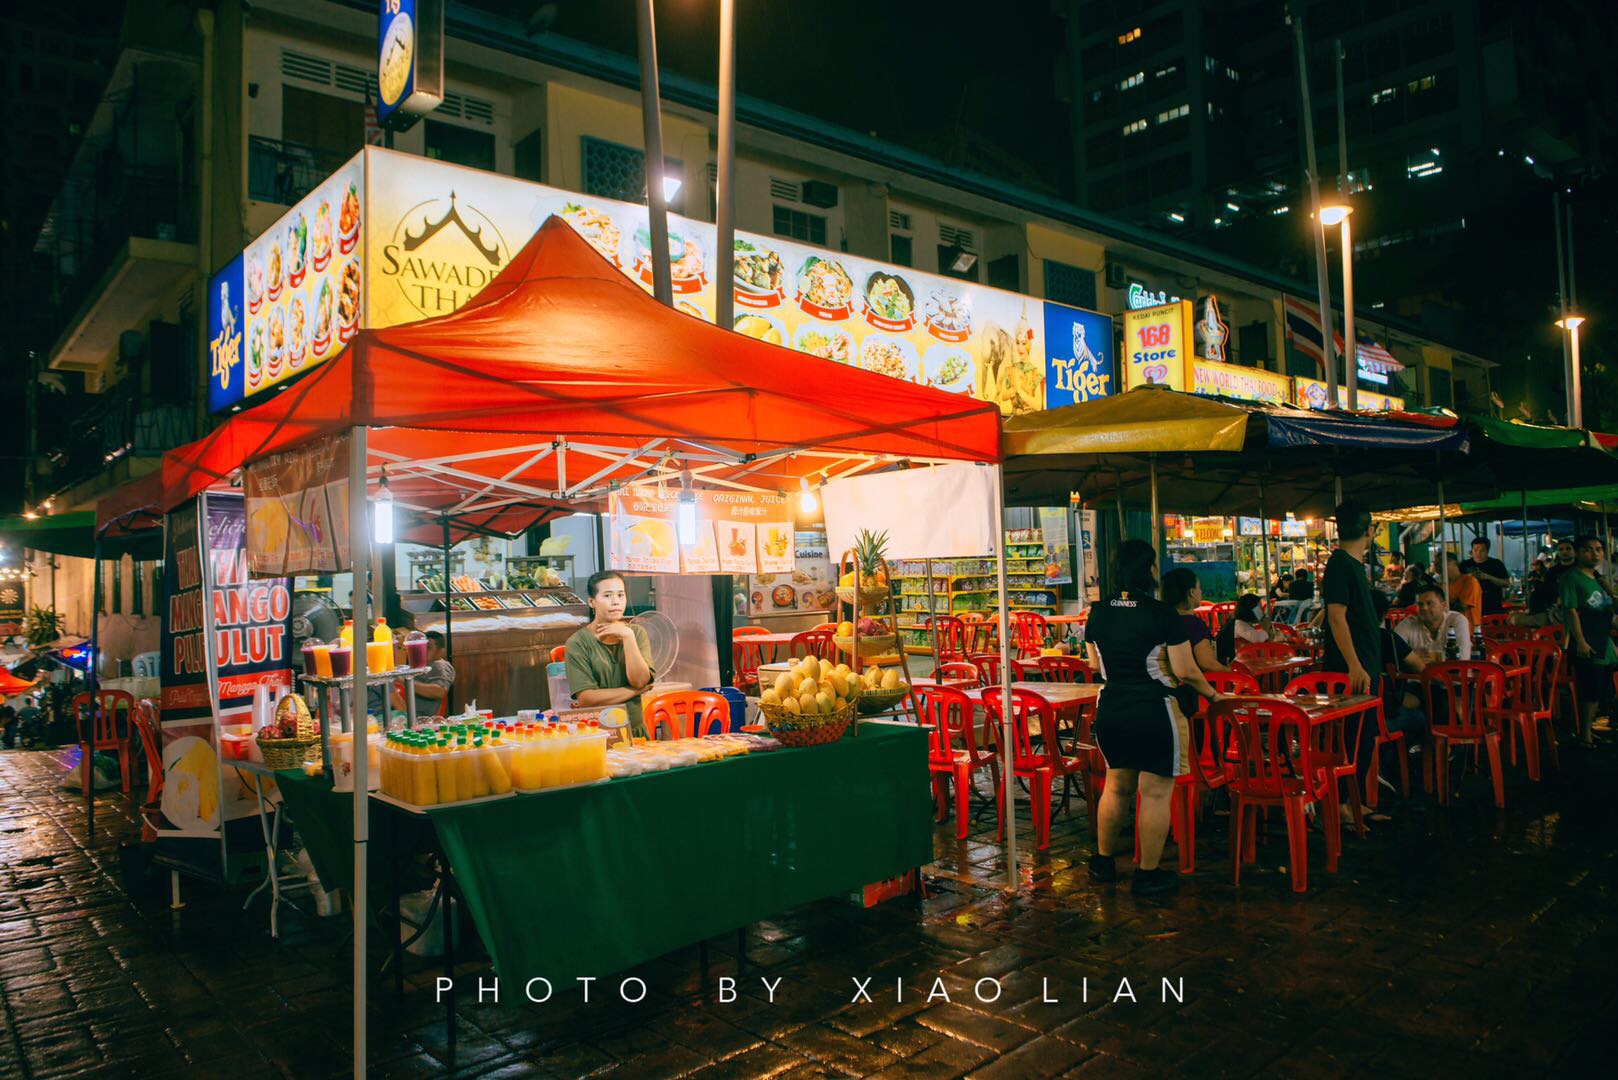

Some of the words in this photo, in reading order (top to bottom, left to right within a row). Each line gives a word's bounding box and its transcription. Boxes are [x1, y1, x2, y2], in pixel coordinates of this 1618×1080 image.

[1137, 323, 1171, 349] 168
[210, 326, 242, 390] Tiger
[1133, 349, 1176, 364] Store
[1052, 358, 1110, 403] Tiger
[1194, 367, 1210, 384] NEW
[1212, 369, 1239, 389] WORLD
[712, 494, 754, 504] ORIGINAL
[795, 549, 823, 559] Cuisine
[170, 589, 204, 634] MANG
[212, 585, 290, 626] ANGO
[1110, 599, 1138, 608] GUINNESS
[174, 632, 207, 675] PULU
[214, 624, 286, 668] ULUT
